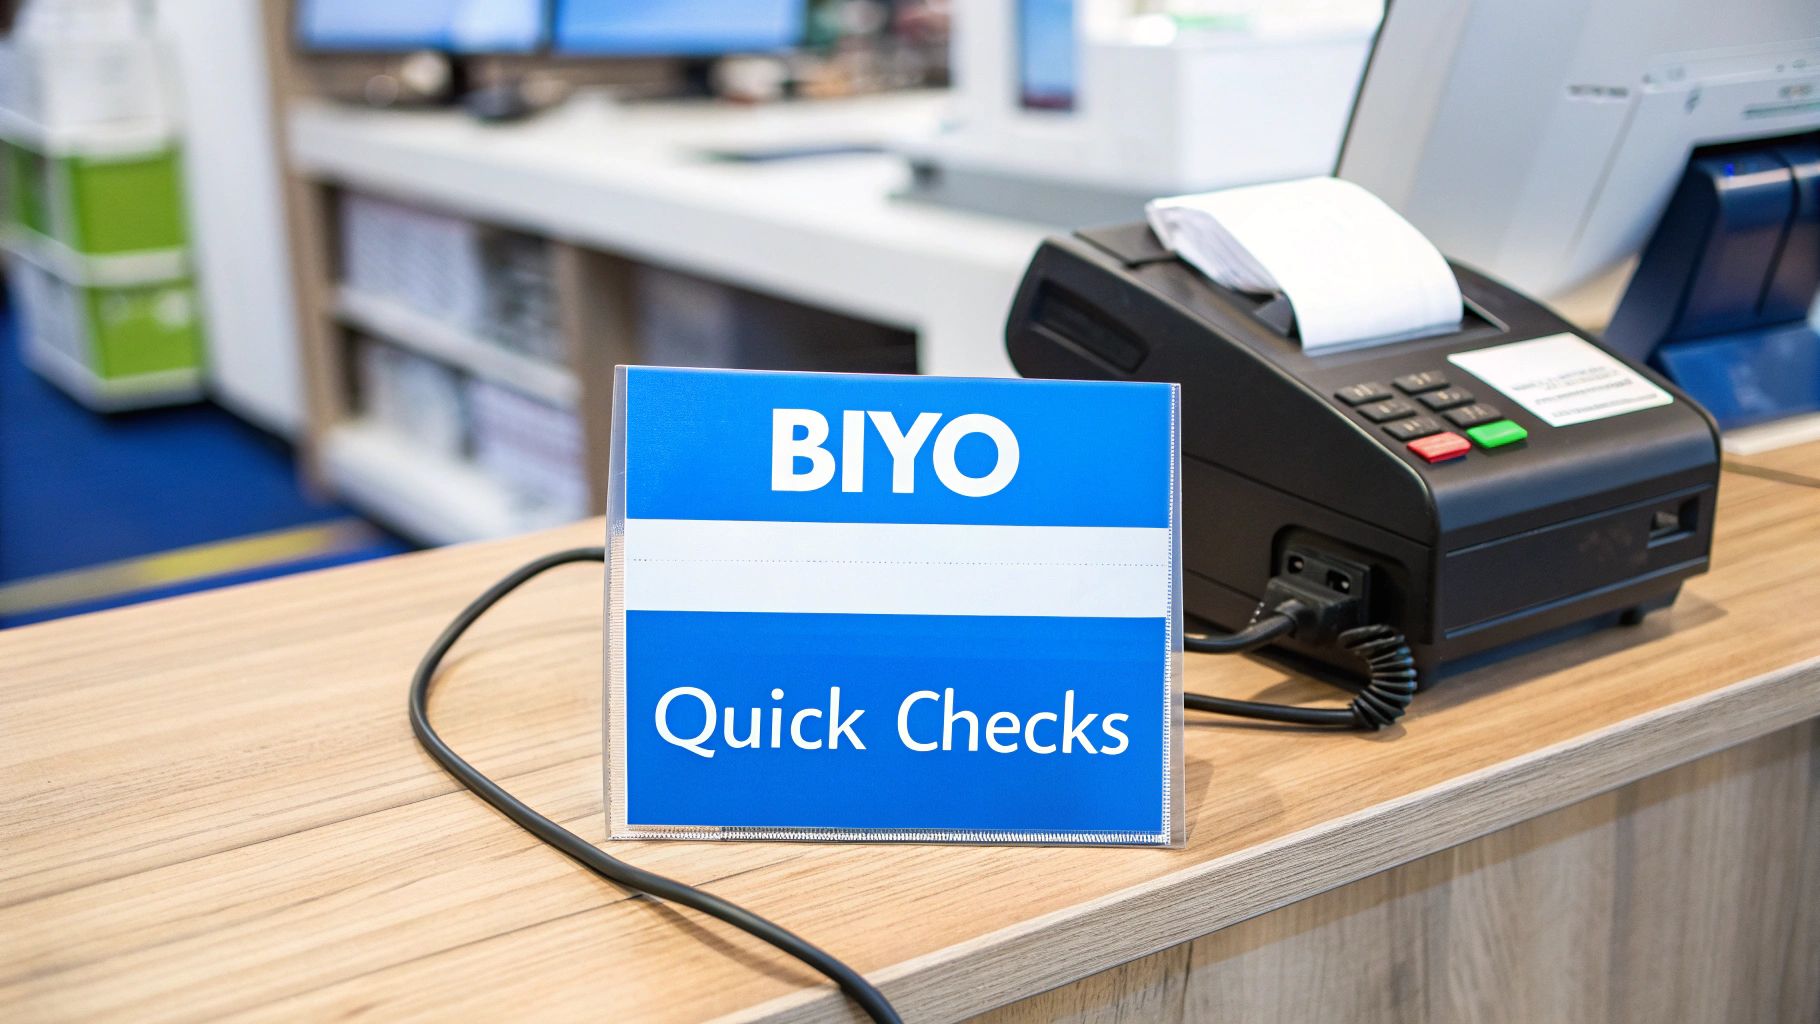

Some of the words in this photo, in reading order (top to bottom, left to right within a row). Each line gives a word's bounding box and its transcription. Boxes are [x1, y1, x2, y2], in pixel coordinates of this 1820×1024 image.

[771, 408, 1020, 498] BIYO
[655, 686, 867, 758] Quick
[897, 687, 1130, 755] Checks
